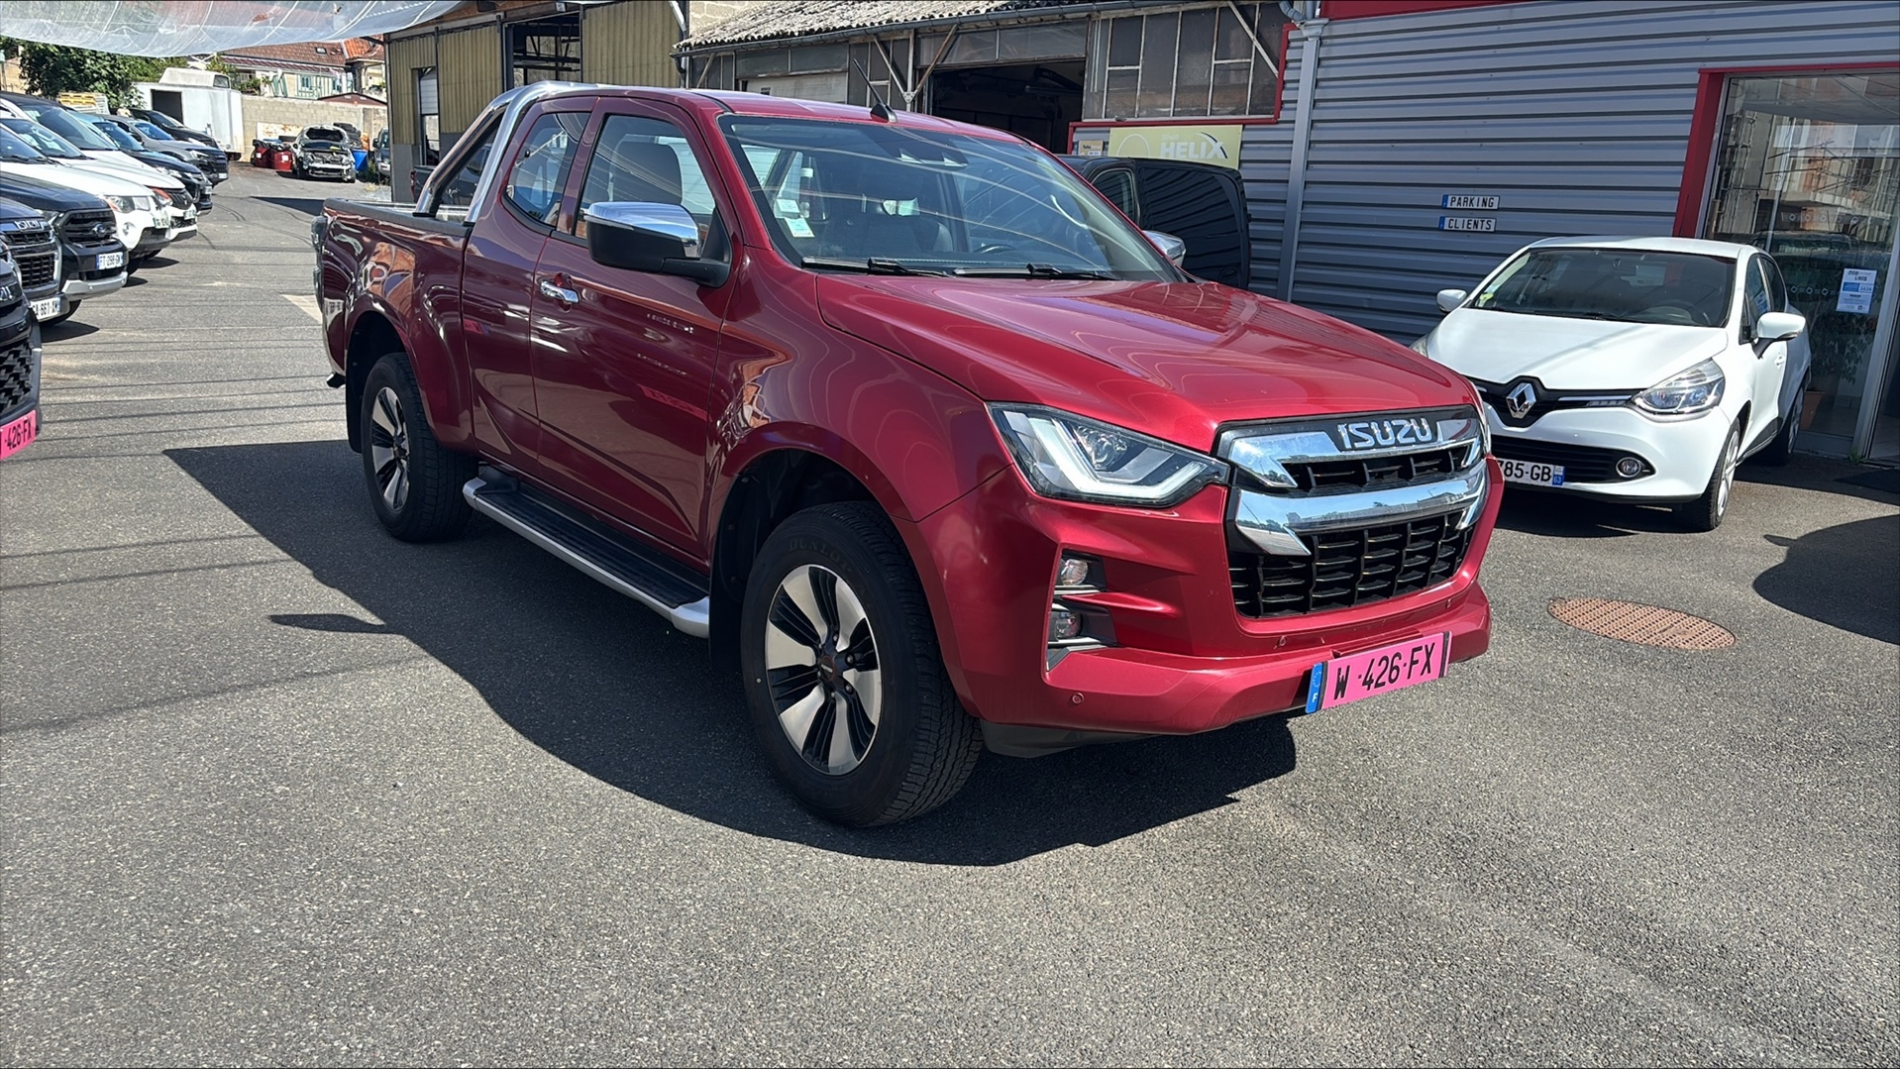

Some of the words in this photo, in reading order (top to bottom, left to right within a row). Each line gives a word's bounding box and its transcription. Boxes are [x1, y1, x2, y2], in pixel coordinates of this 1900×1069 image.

[1160, 135, 1228, 160] HELIX
[1450, 196, 1495, 208] PARKING
[1448, 218, 1492, 230] CLIENTS
[1337, 417, 1433, 450] ISUZU
[788, 537, 851, 573] DUNLOP
